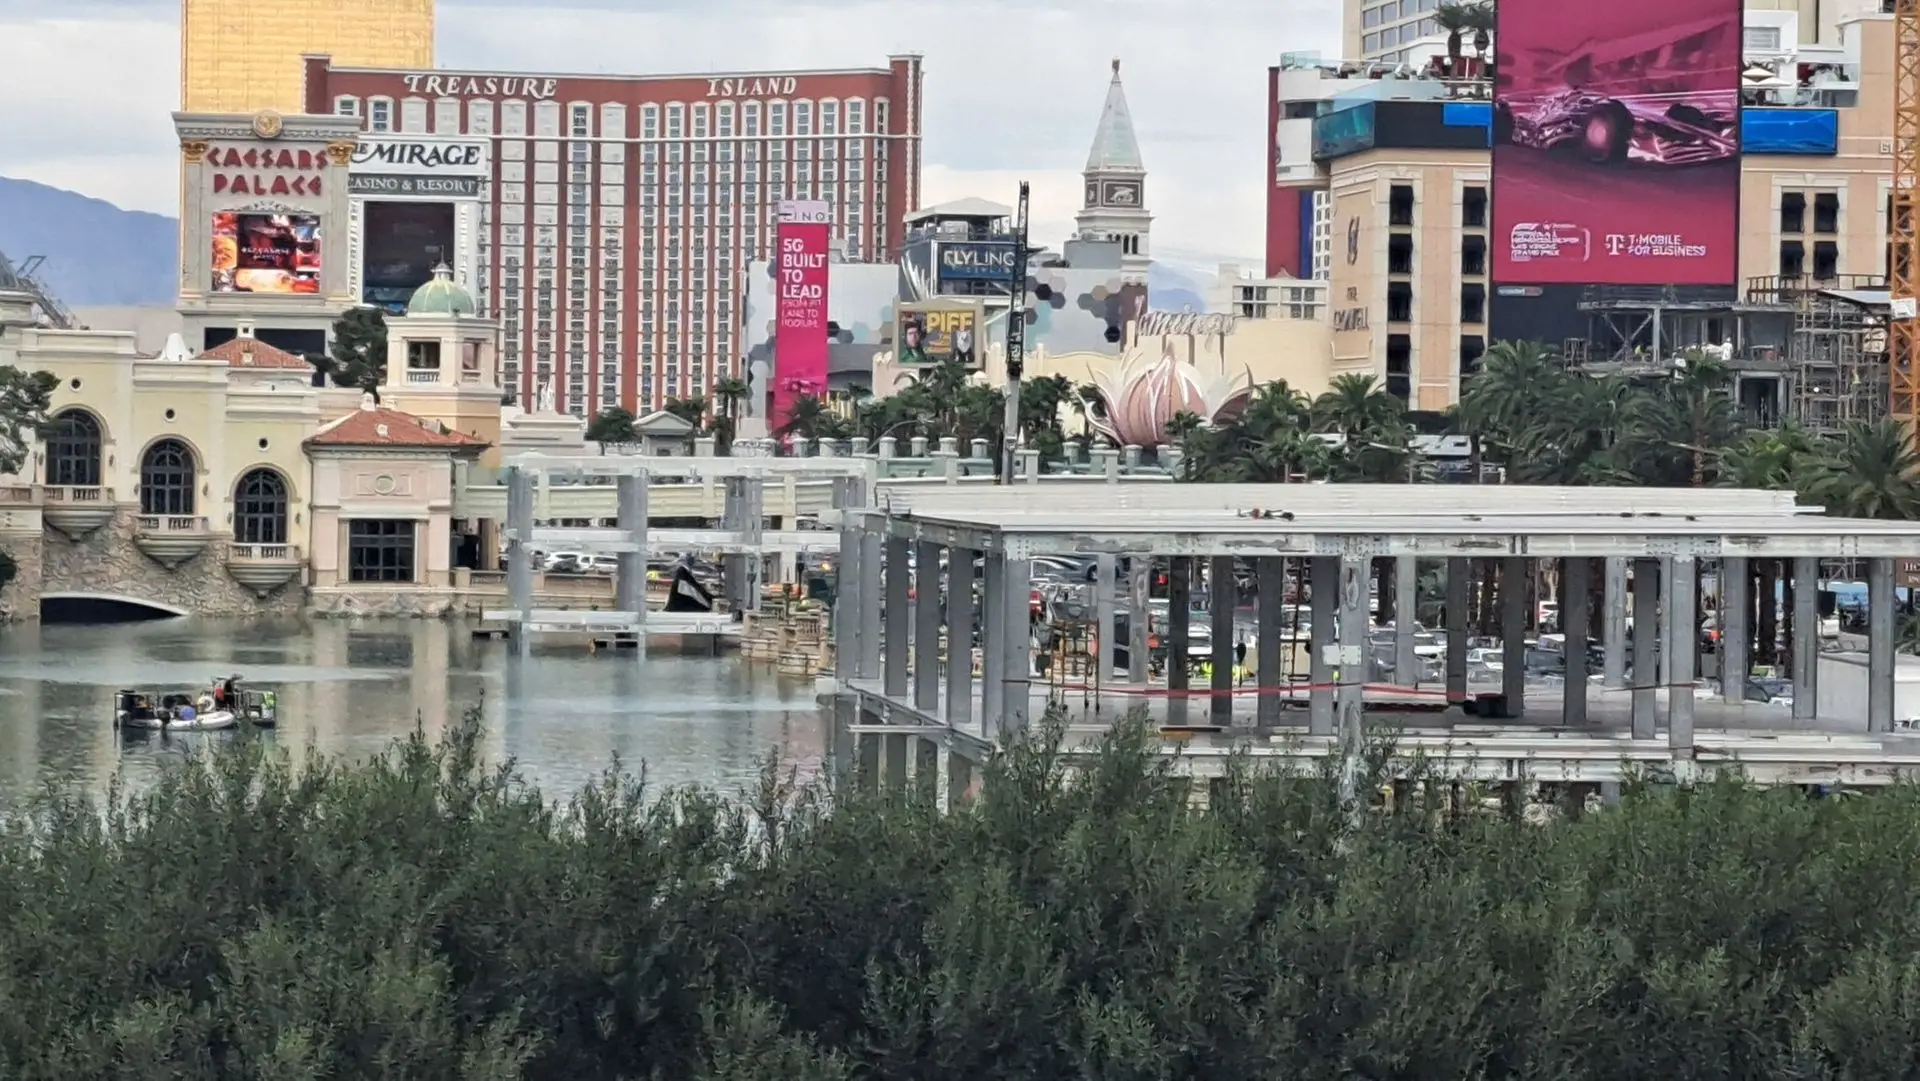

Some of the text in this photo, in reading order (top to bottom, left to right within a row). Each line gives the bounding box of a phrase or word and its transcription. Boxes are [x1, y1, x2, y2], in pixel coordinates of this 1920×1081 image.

[404, 74, 797, 99] TREASURE ISLAND
[207, 147, 328, 170] CAESARS
[350, 143, 481, 168] MIRAGE
[213, 173, 322, 196] PALACE
[401, 180, 412, 190] &
[416, 179, 475, 192] RESORT
[783, 238, 804, 252] 5G
[1627, 245, 1706, 256] FOR BUSINESS
[783, 253, 826, 268] BUILT
[782, 269, 803, 283] TO
[783, 284, 822, 299] LEAD
[926, 312, 974, 333] PIFF
